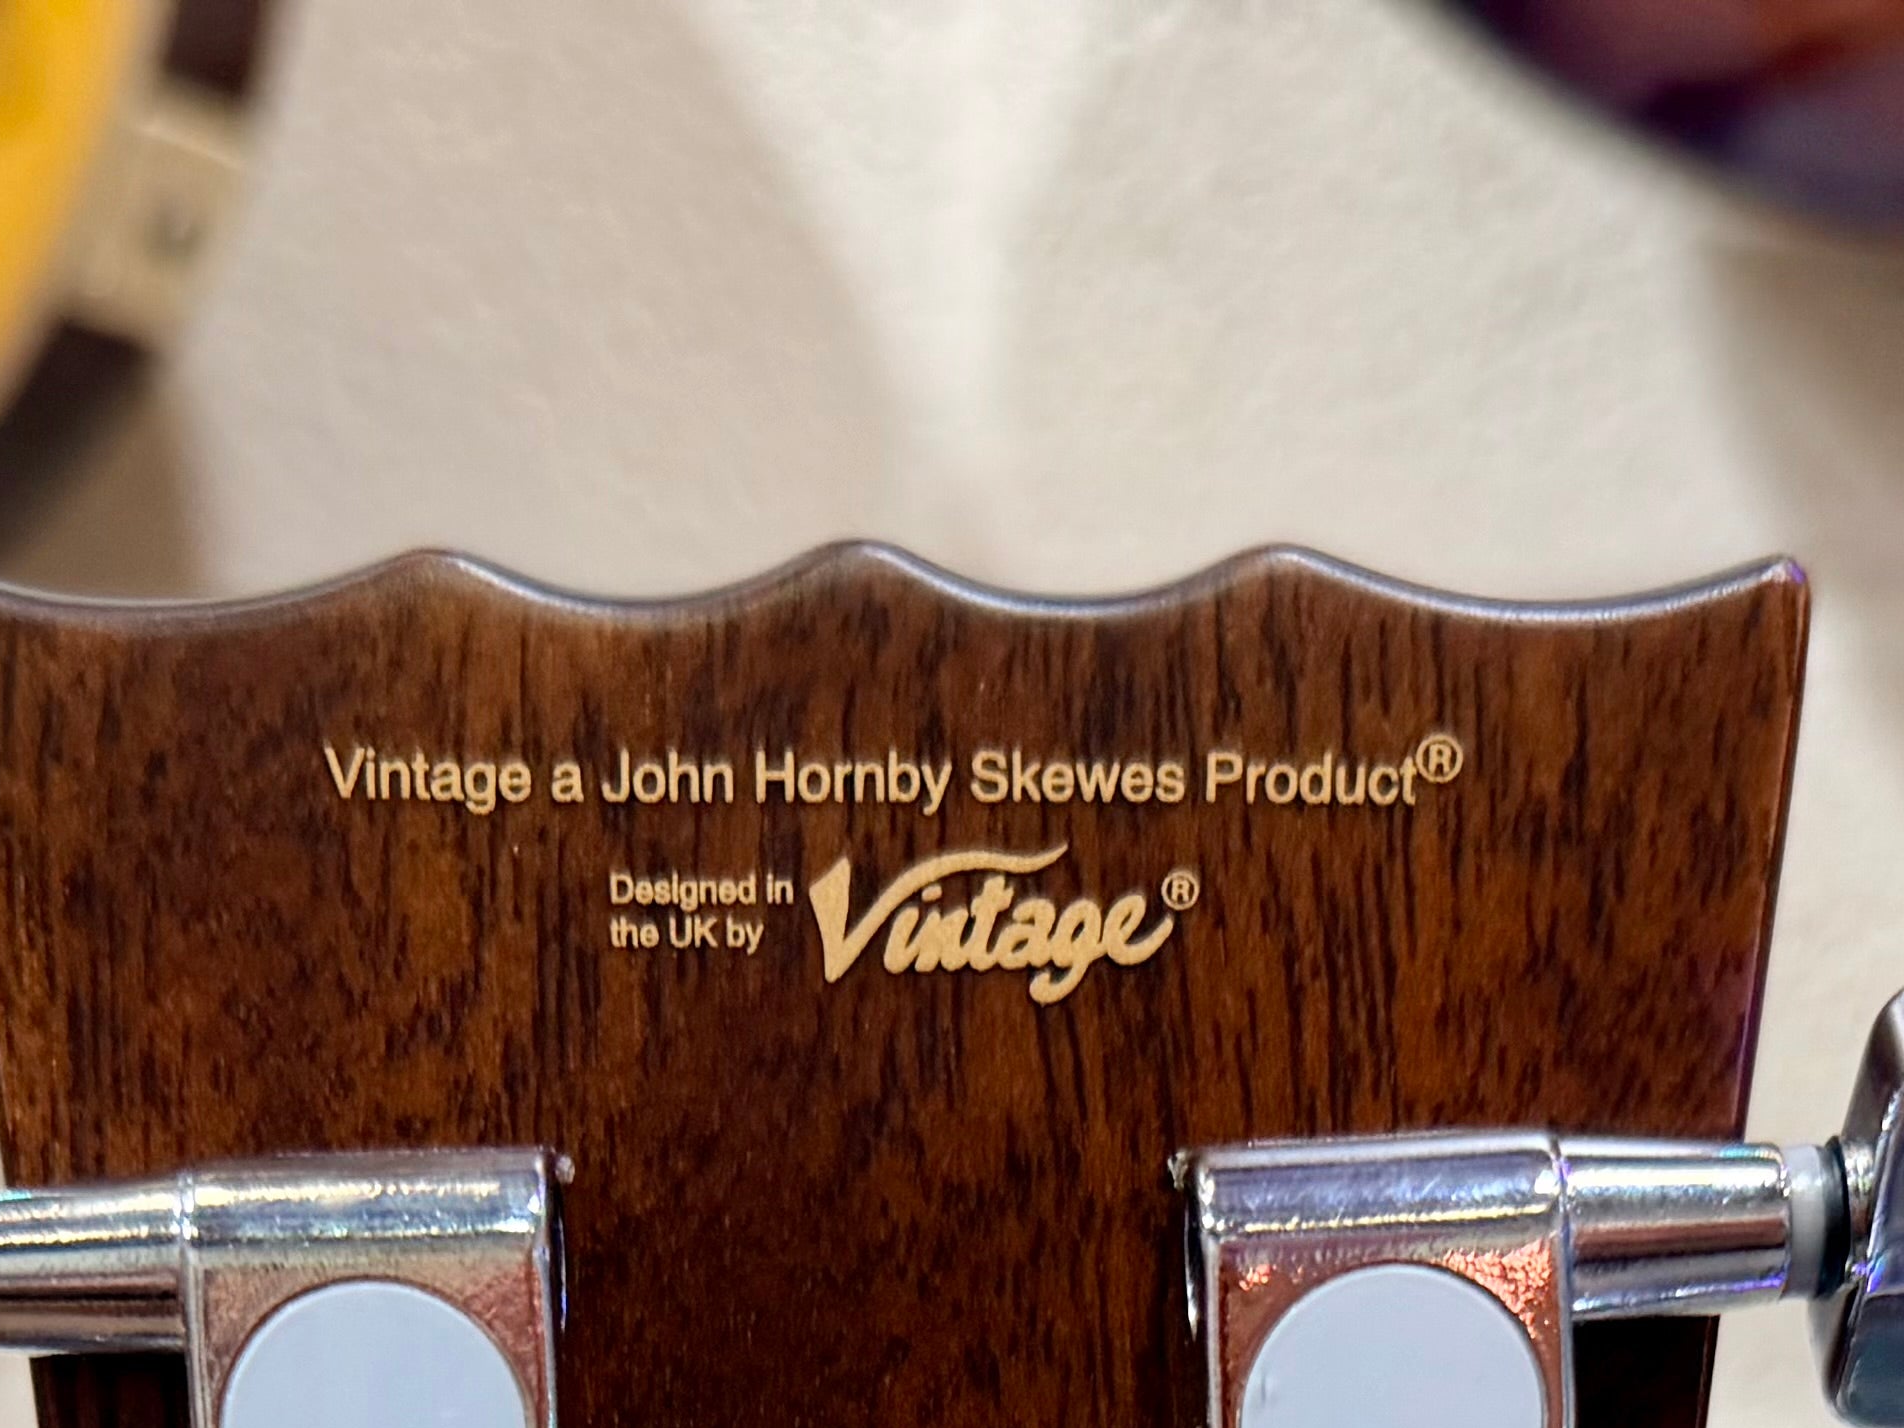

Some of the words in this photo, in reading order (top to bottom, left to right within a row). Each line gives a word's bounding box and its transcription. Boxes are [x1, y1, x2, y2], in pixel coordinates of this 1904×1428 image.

[324, 745, 532, 815] Vintage
[551, 761, 585, 802] a
[601, 747, 734, 803] John
[755, 748, 953, 815] Hornby
[970, 747, 1185, 803] Skewes
[609, 869, 757, 912] Designed
[766, 870, 794, 904] in
[609, 915, 660, 948] the
[669, 914, 718, 948] UK
[726, 914, 764, 955] by
